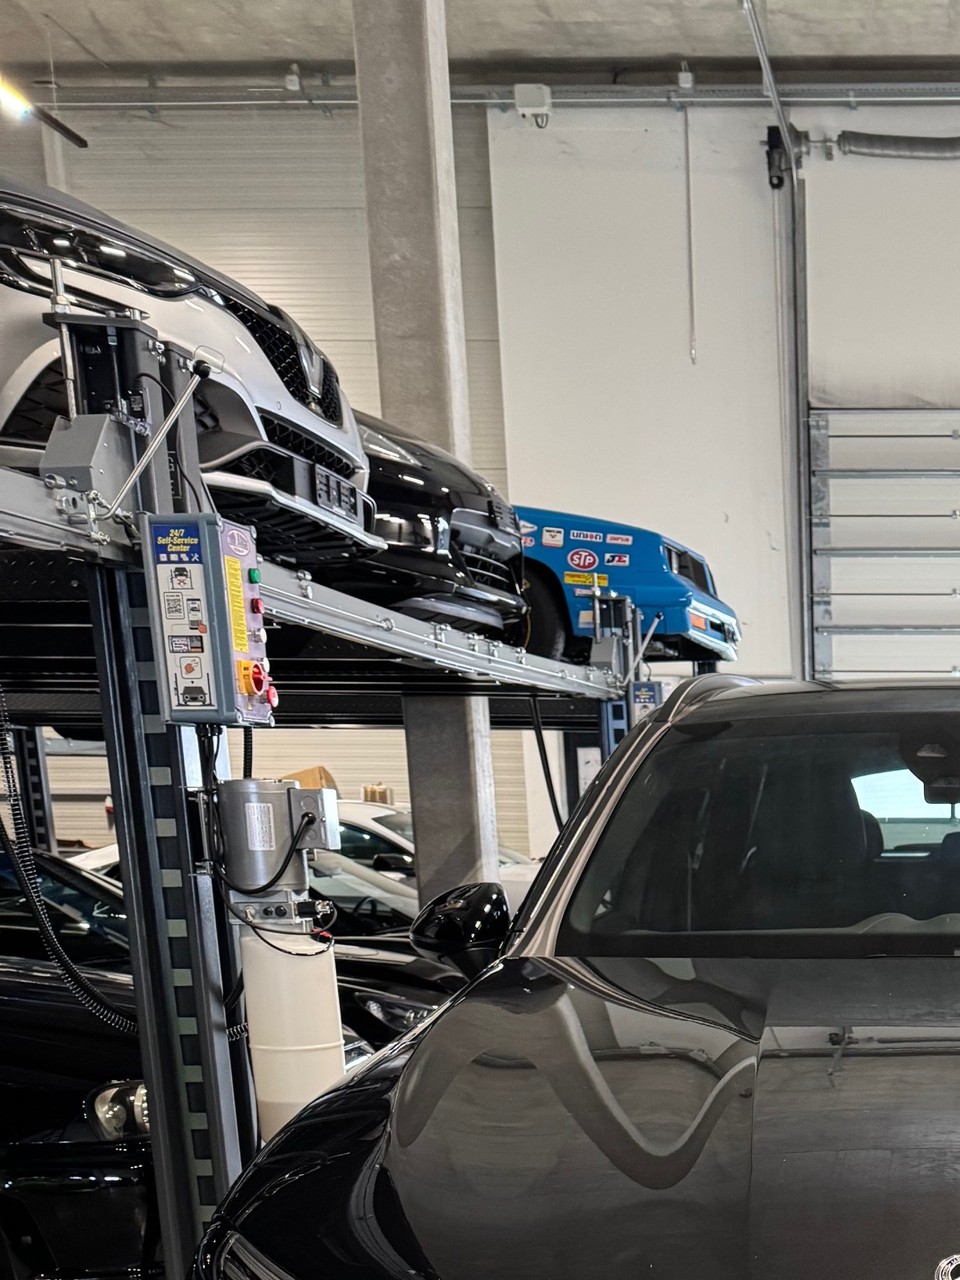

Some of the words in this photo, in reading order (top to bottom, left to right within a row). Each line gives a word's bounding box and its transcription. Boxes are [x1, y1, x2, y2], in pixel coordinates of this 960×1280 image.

[169, 529, 185, 537] 24/7
[157, 536, 199, 545] Self-Service
[167, 544, 191, 552] Center
[572, 551, 594, 566] STP
[606, 554, 627, 564] JE
